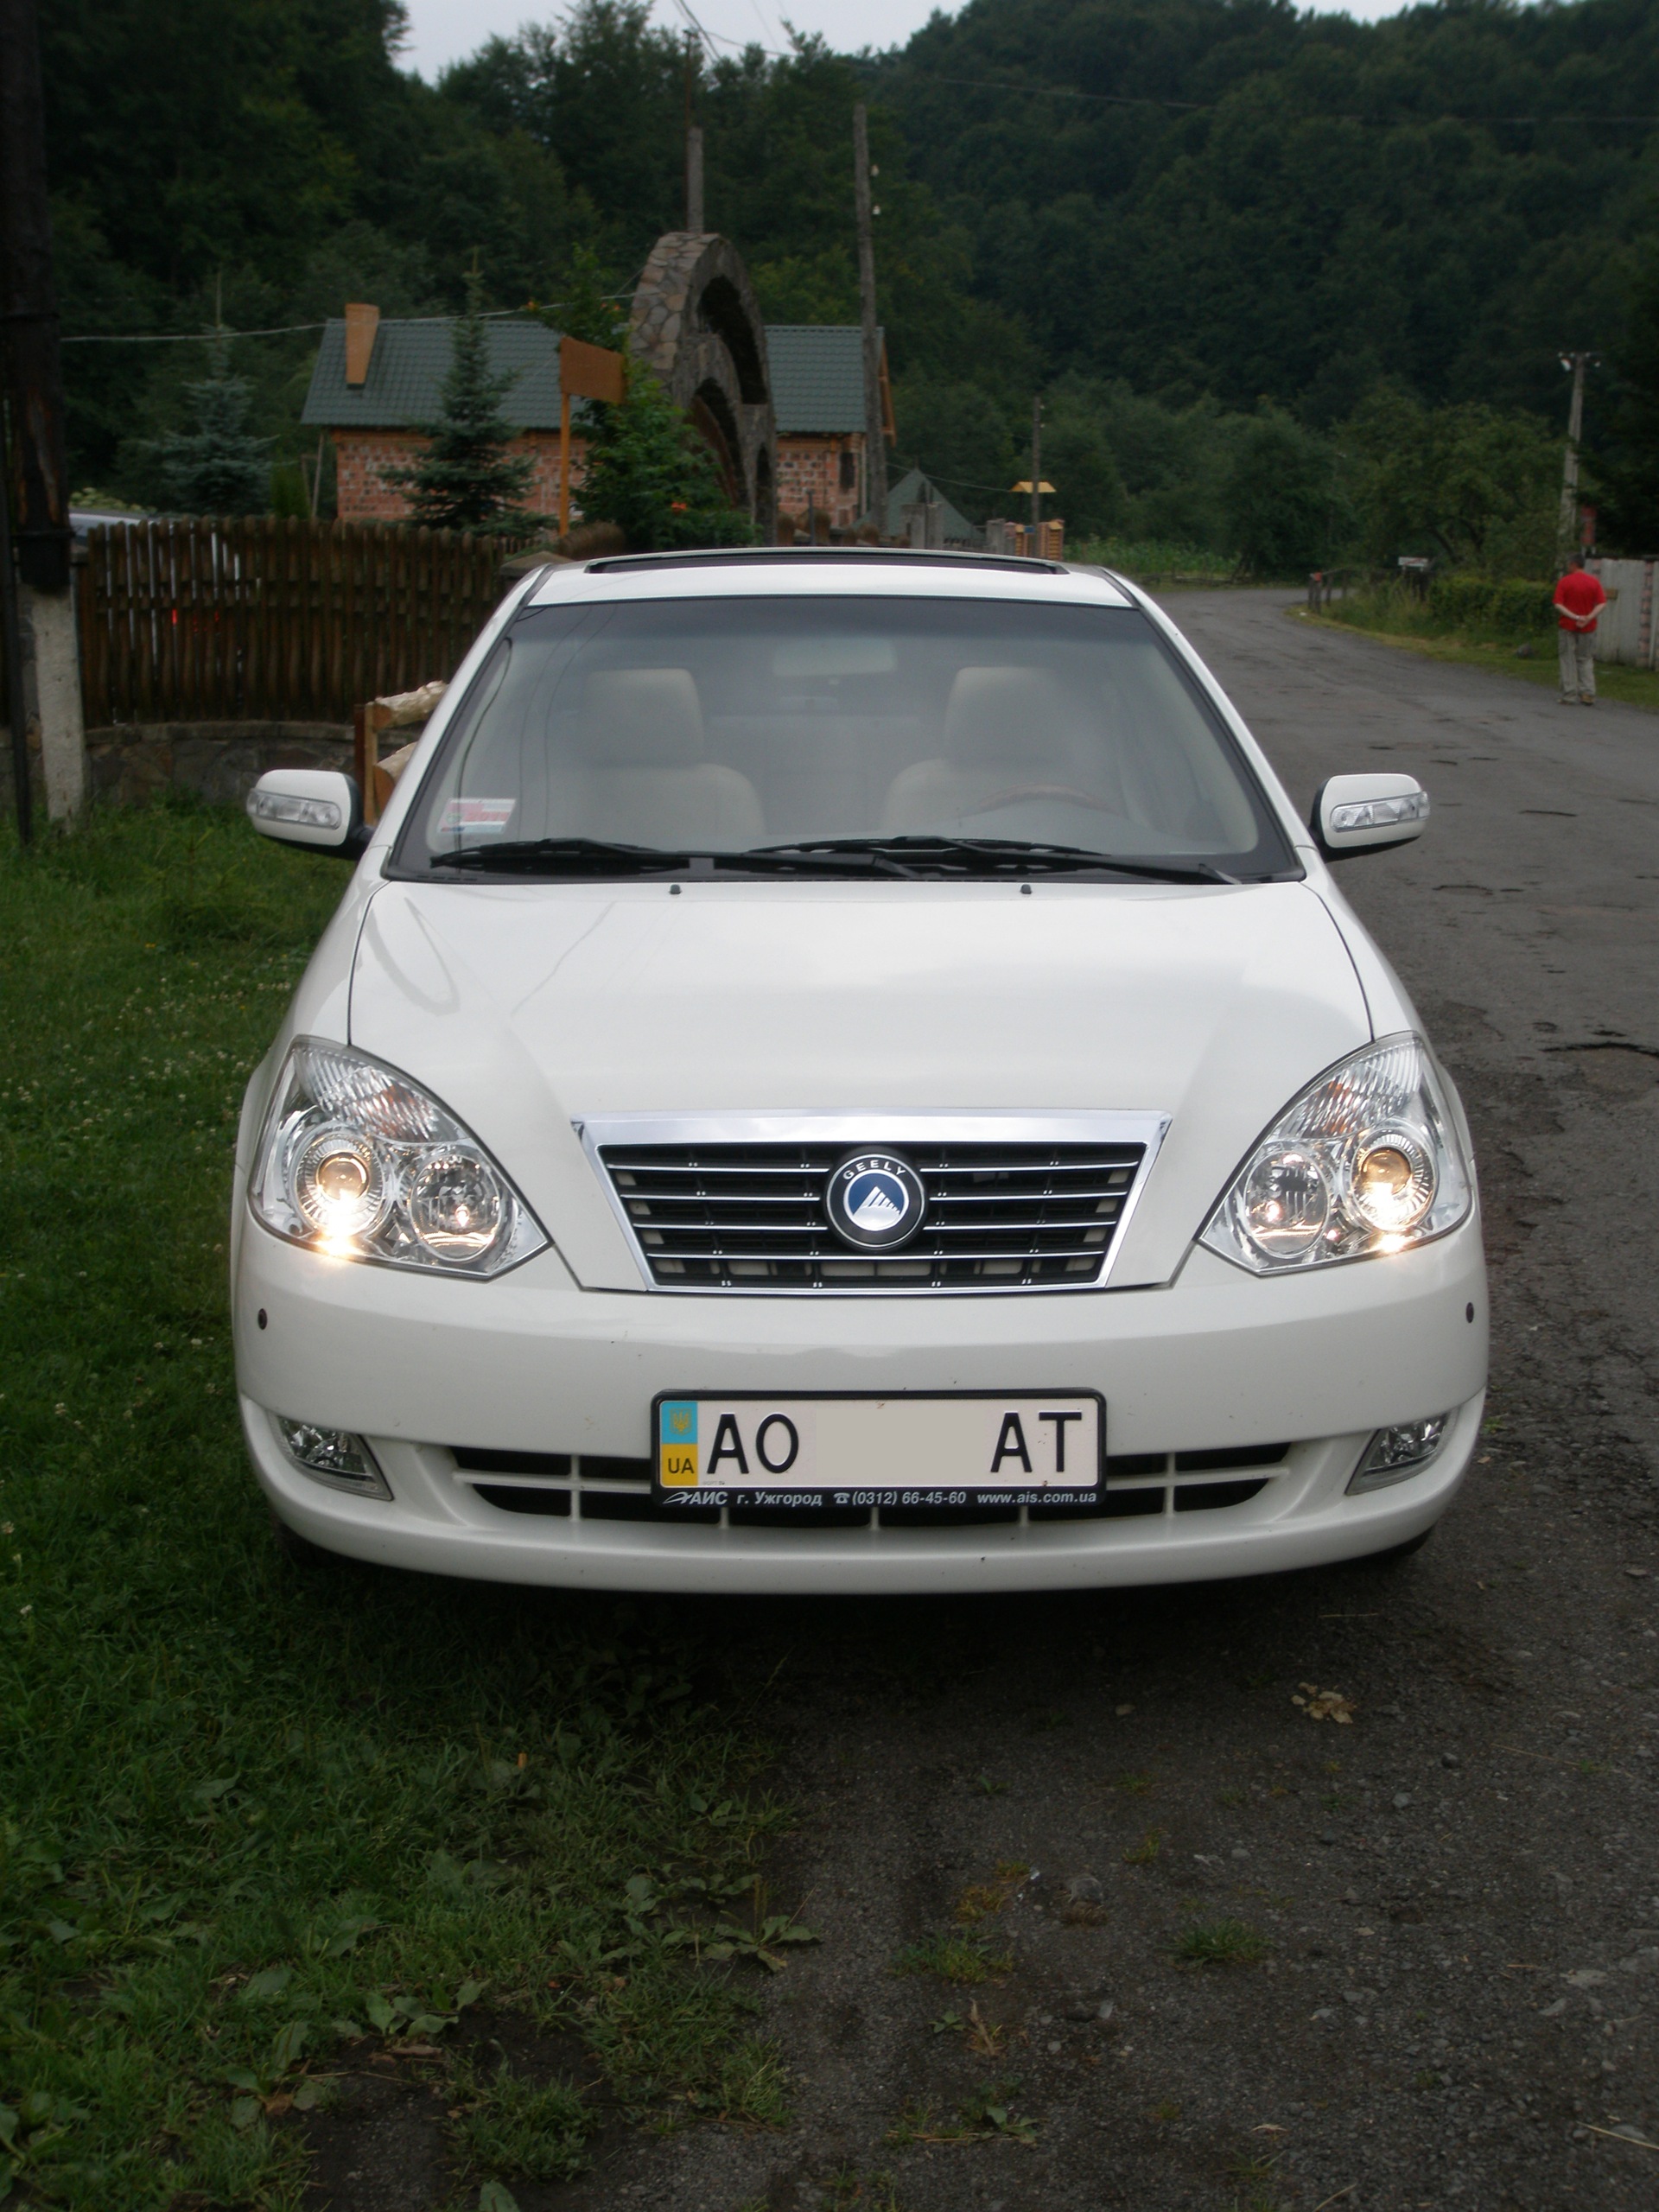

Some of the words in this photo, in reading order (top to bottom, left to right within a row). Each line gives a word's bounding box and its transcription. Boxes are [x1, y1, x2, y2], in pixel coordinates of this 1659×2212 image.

[842, 1160, 906, 1179] GEELY
[707, 1414, 799, 1474] AO
[990, 1412, 1083, 1472] AT
[668, 1458, 695, 1474] UA
[754, 1491, 823, 1507] Ужгород
[852, 1491, 898, 1506] (0312)
[902, 1491, 967, 1504] 66-45-60
[977, 1491, 1096, 1504] www.ais.com.ua
